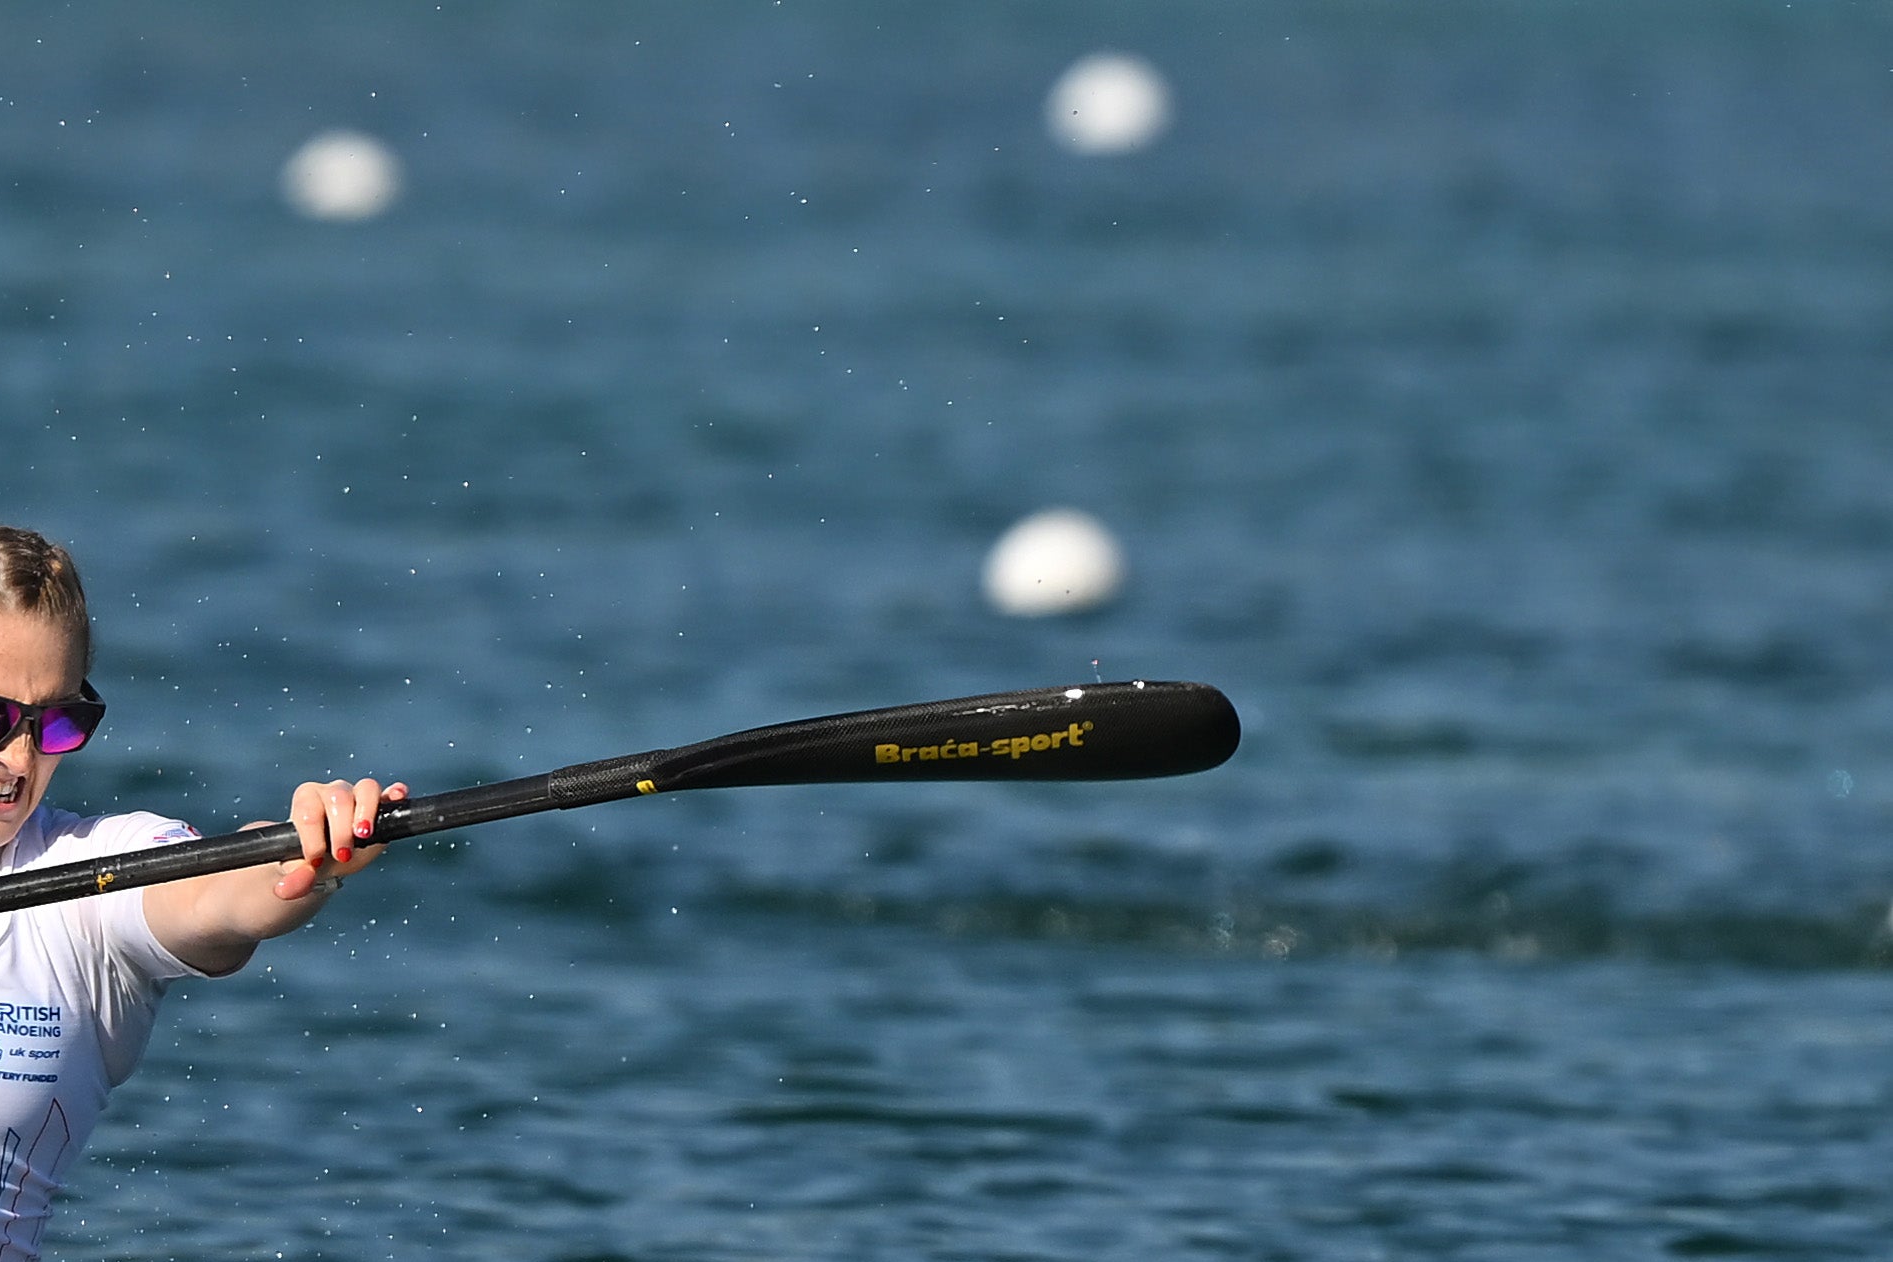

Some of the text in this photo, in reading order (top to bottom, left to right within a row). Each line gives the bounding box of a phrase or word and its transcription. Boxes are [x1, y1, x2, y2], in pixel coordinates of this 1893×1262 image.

[9, 1047, 60, 1060] uk sport
[22, 1073, 58, 1083] FUNDED
